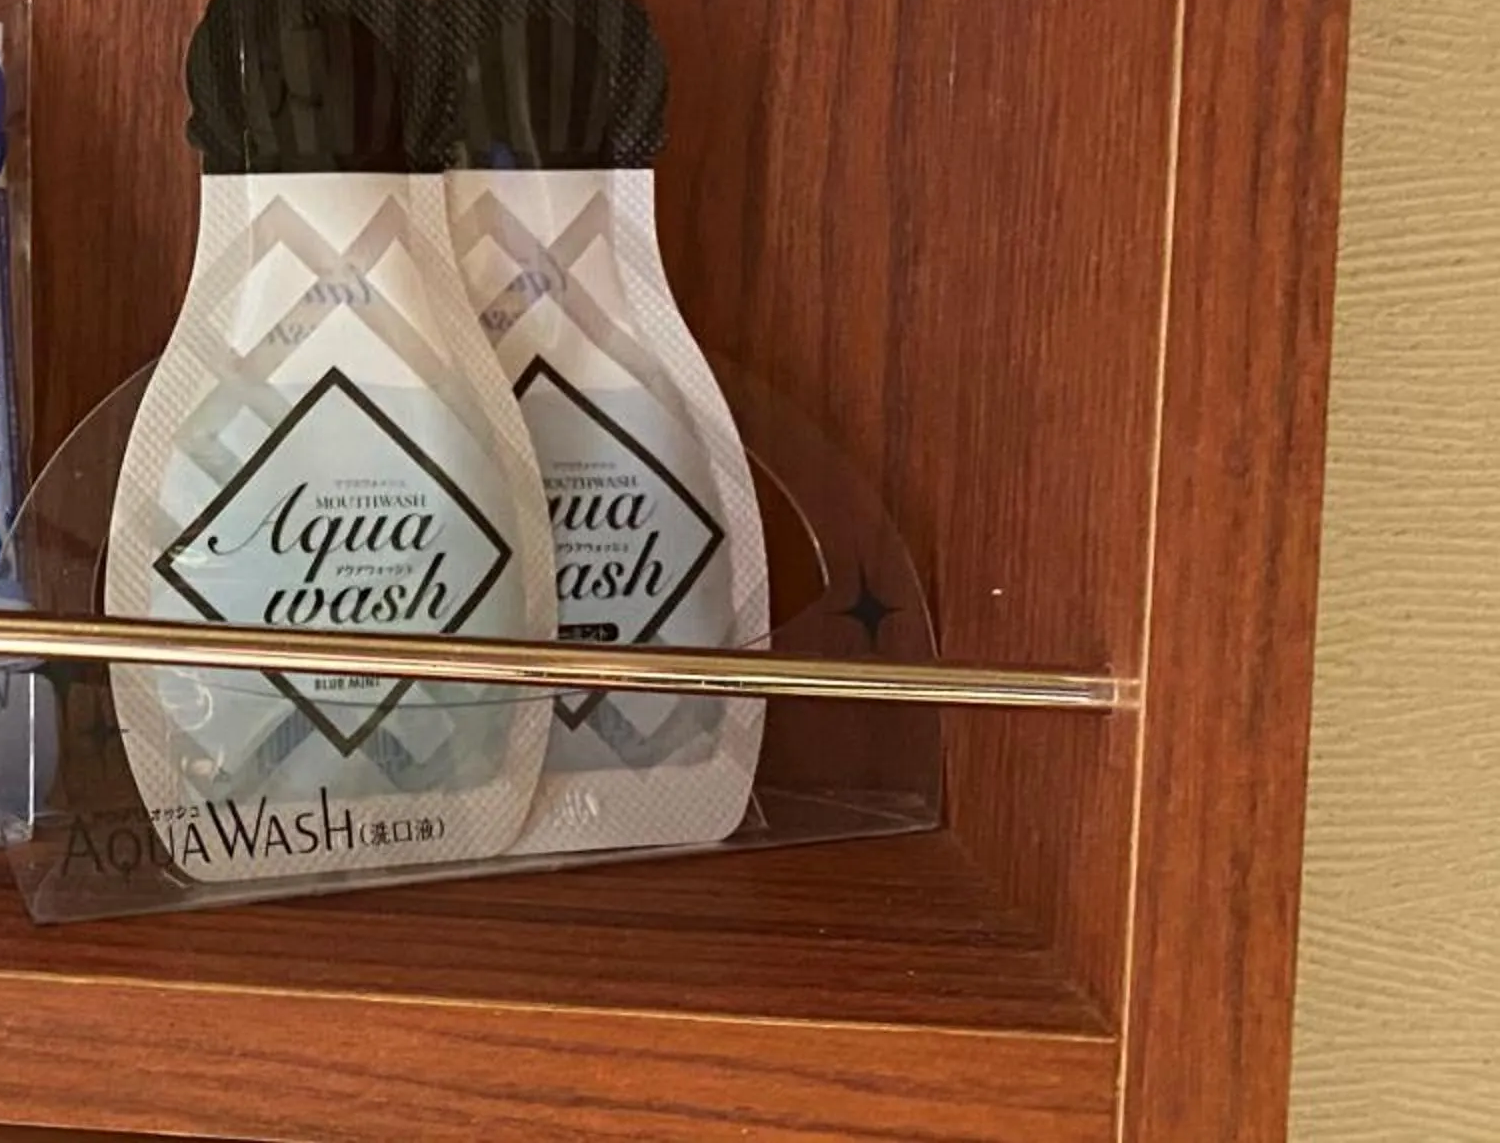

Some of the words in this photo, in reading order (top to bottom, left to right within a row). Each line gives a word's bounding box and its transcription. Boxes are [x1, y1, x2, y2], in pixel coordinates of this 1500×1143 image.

[207, 482, 447, 584] Aqua
[315, 493, 427, 510] MOUTHWASH
[548, 492, 658, 531] ua
[263, 552, 458, 625] wash
[555, 529, 674, 601] ash
